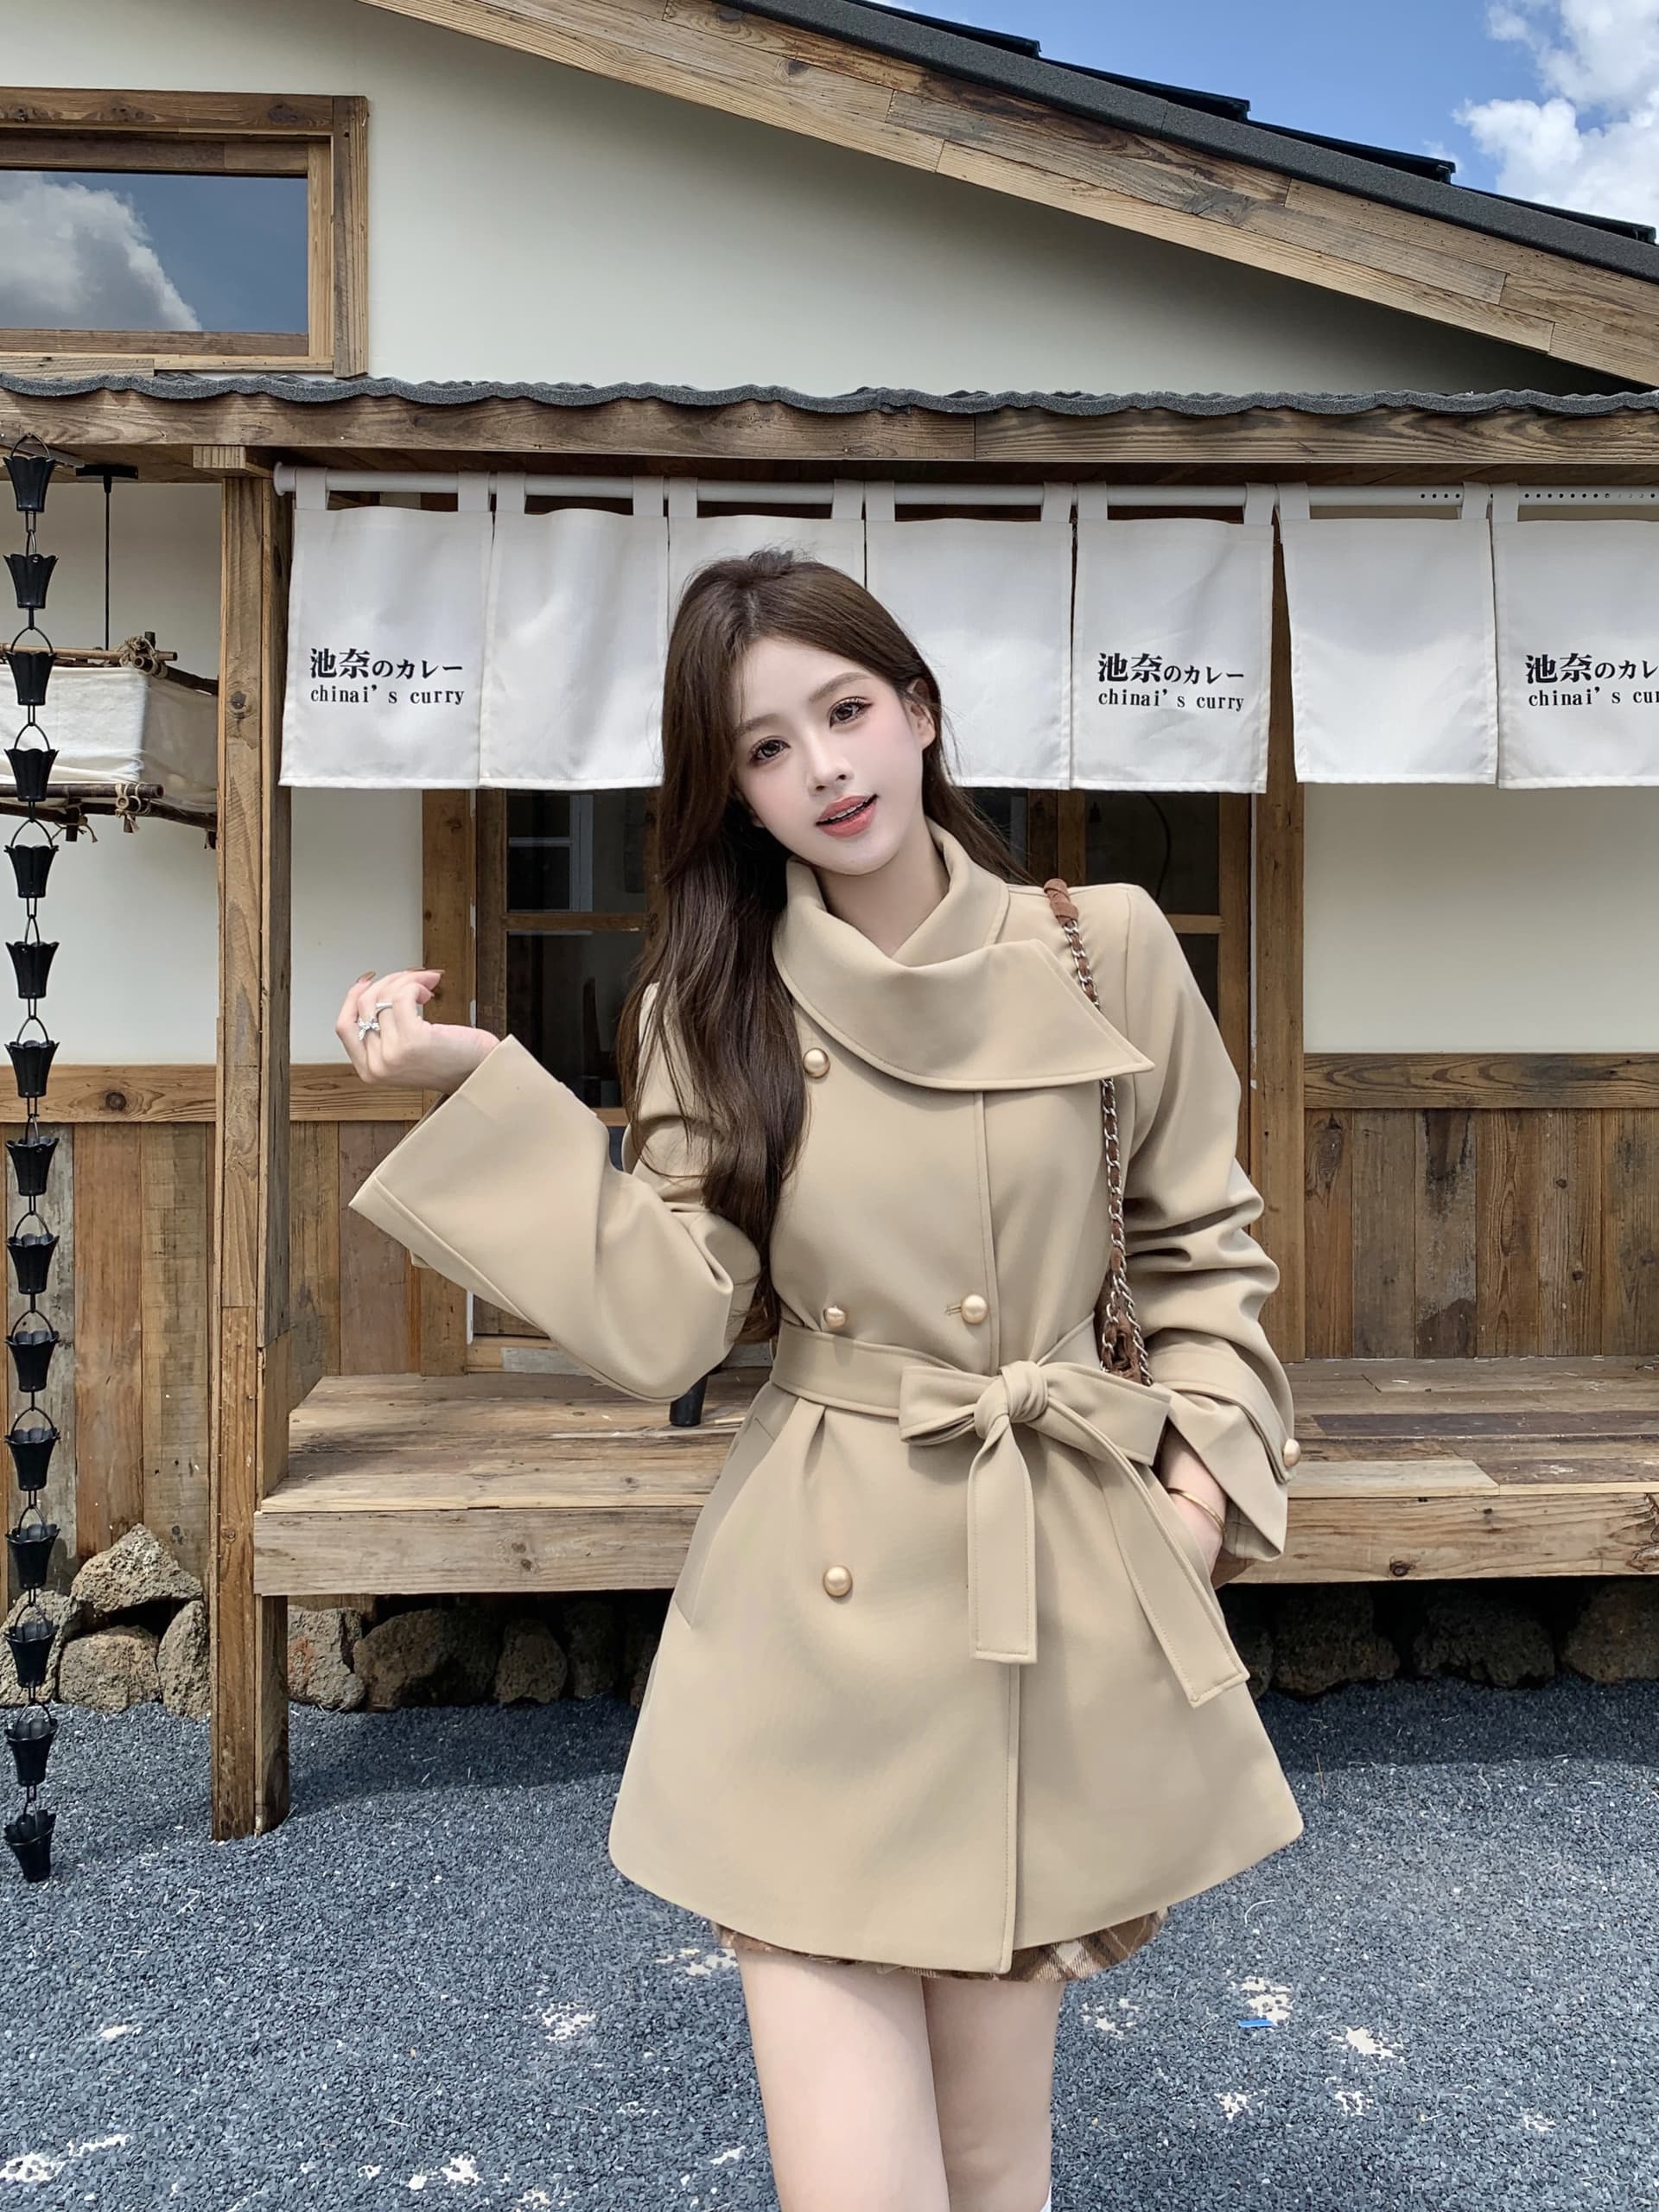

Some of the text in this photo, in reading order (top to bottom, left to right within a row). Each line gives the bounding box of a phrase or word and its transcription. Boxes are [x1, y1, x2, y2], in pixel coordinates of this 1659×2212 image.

[310, 647, 463, 680] 池奈のカレー
[1097, 652, 1244, 685] 池奈のカレー
[410, 690, 466, 705] curry
[1196, 696, 1244, 712] curry
